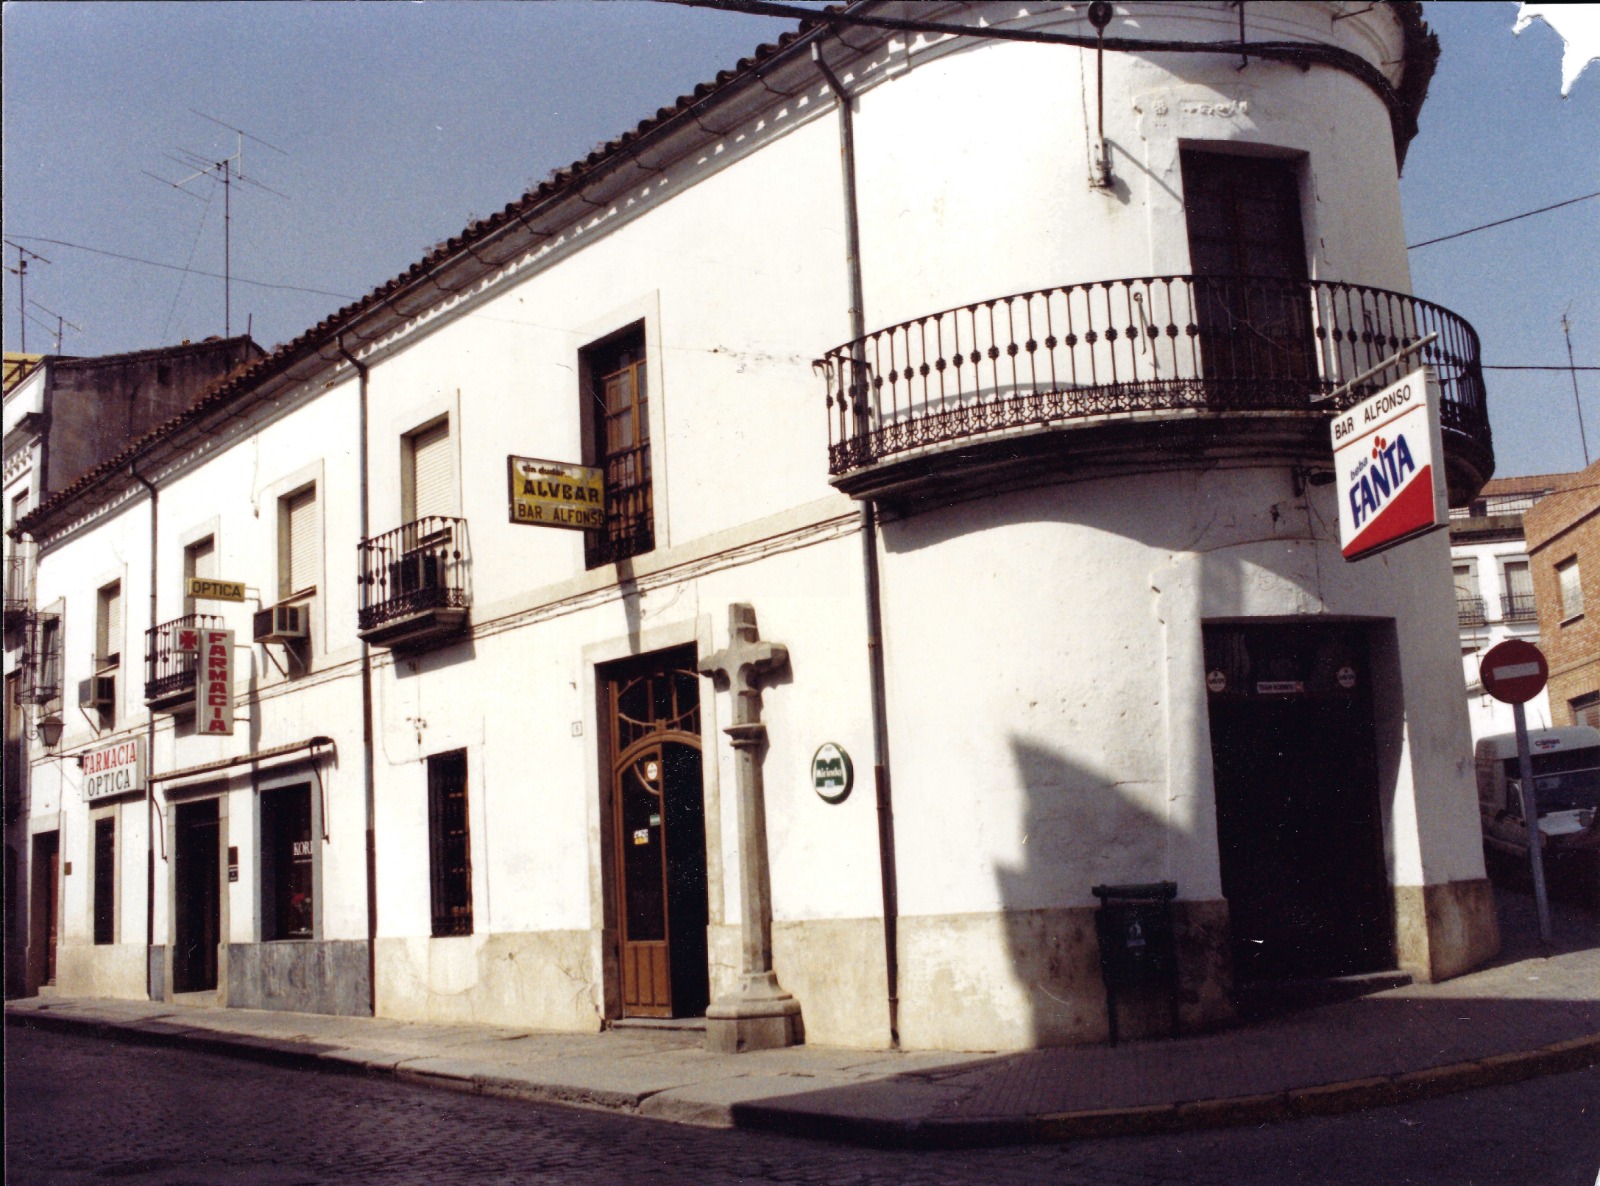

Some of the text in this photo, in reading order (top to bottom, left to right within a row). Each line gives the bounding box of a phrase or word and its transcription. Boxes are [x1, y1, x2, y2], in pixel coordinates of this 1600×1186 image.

[1335, 384, 1411, 440] BAR ALFONSO
[1349, 433, 1415, 529] FANTA
[1350, 456, 1369, 482] beba
[523, 480, 599, 502] ALVBAR
[518, 503, 604, 525] BAR ALFONSO
[192, 581, 242, 597] OPTICA
[208, 632, 227, 731] FARMACIA
[84, 742, 136, 775] FARMACIA
[88, 769, 130, 796] OPTICA
